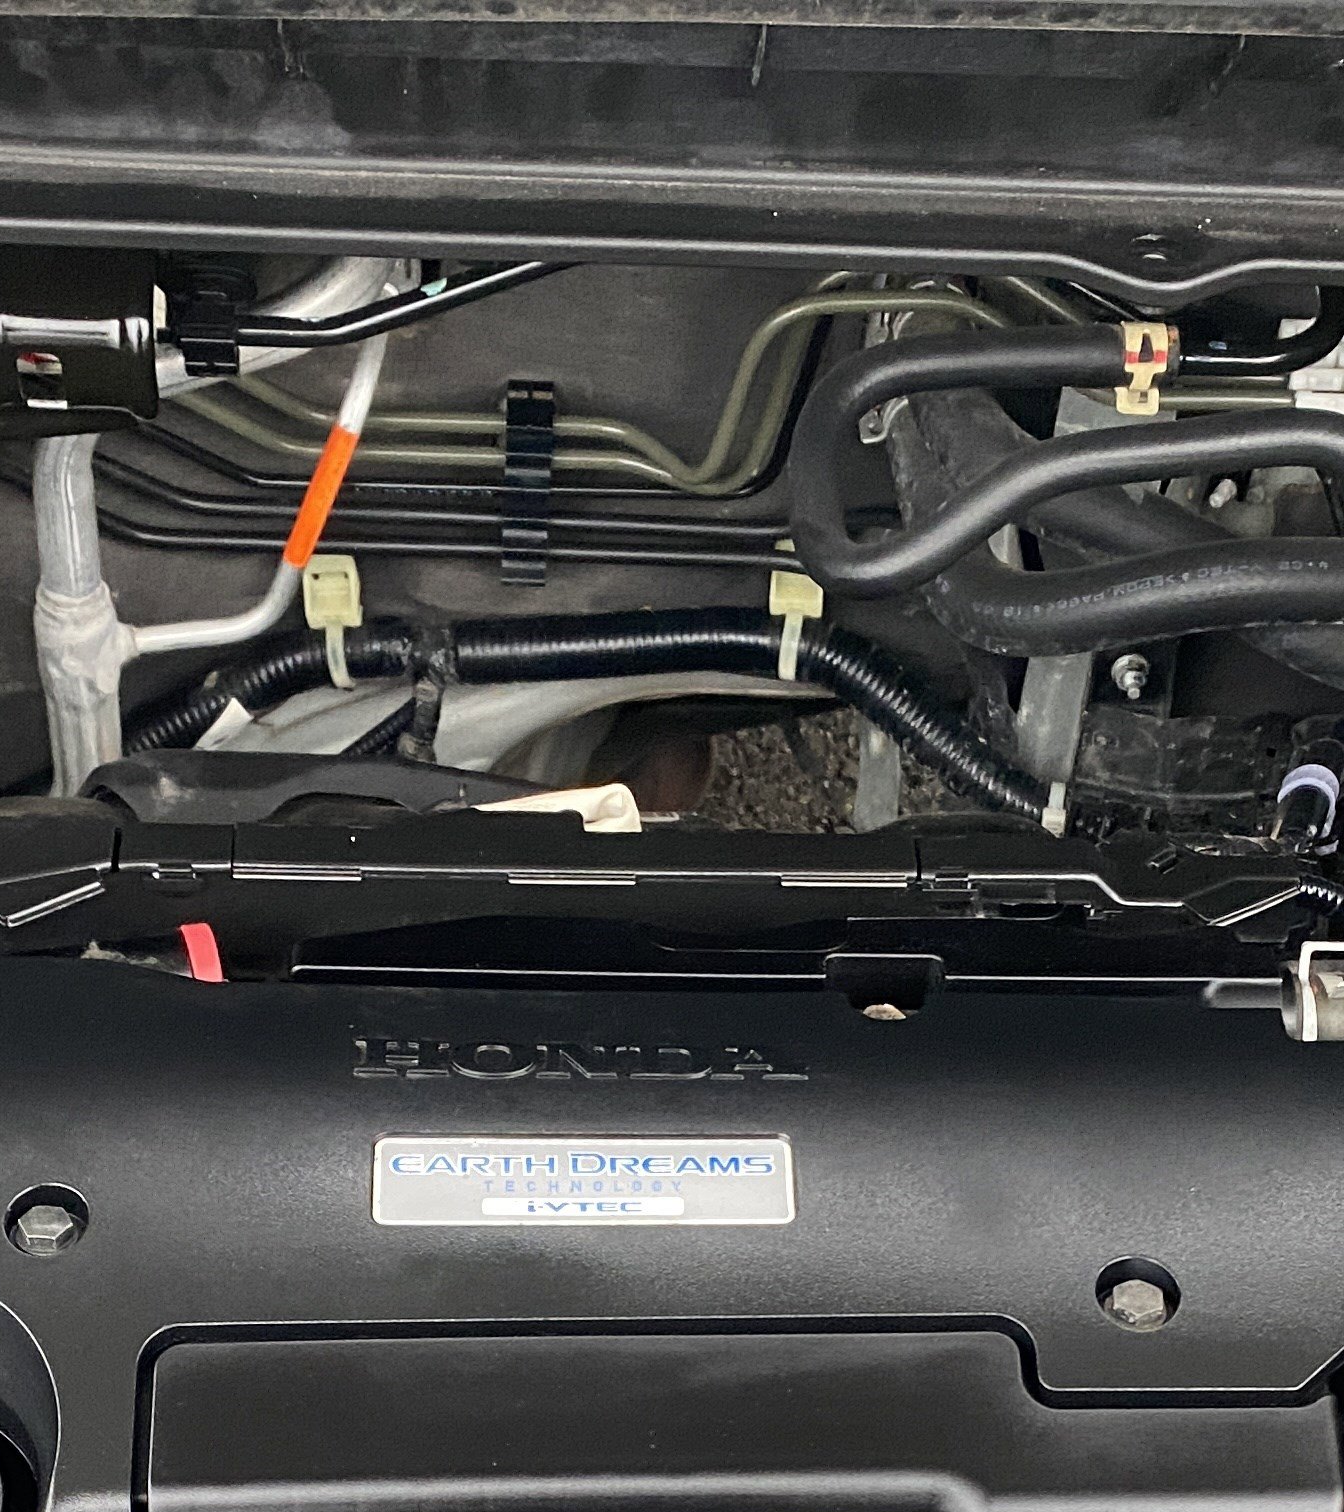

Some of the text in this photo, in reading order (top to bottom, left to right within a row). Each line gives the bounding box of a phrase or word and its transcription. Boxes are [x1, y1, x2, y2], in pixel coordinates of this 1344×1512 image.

[351, 1038, 809, 1081] HONDA
[390, 1150, 776, 1177] EARTH DREAMS
[483, 1179, 683, 1194] TECHNOLOGY
[526, 1198, 645, 1214] i-VTEC
